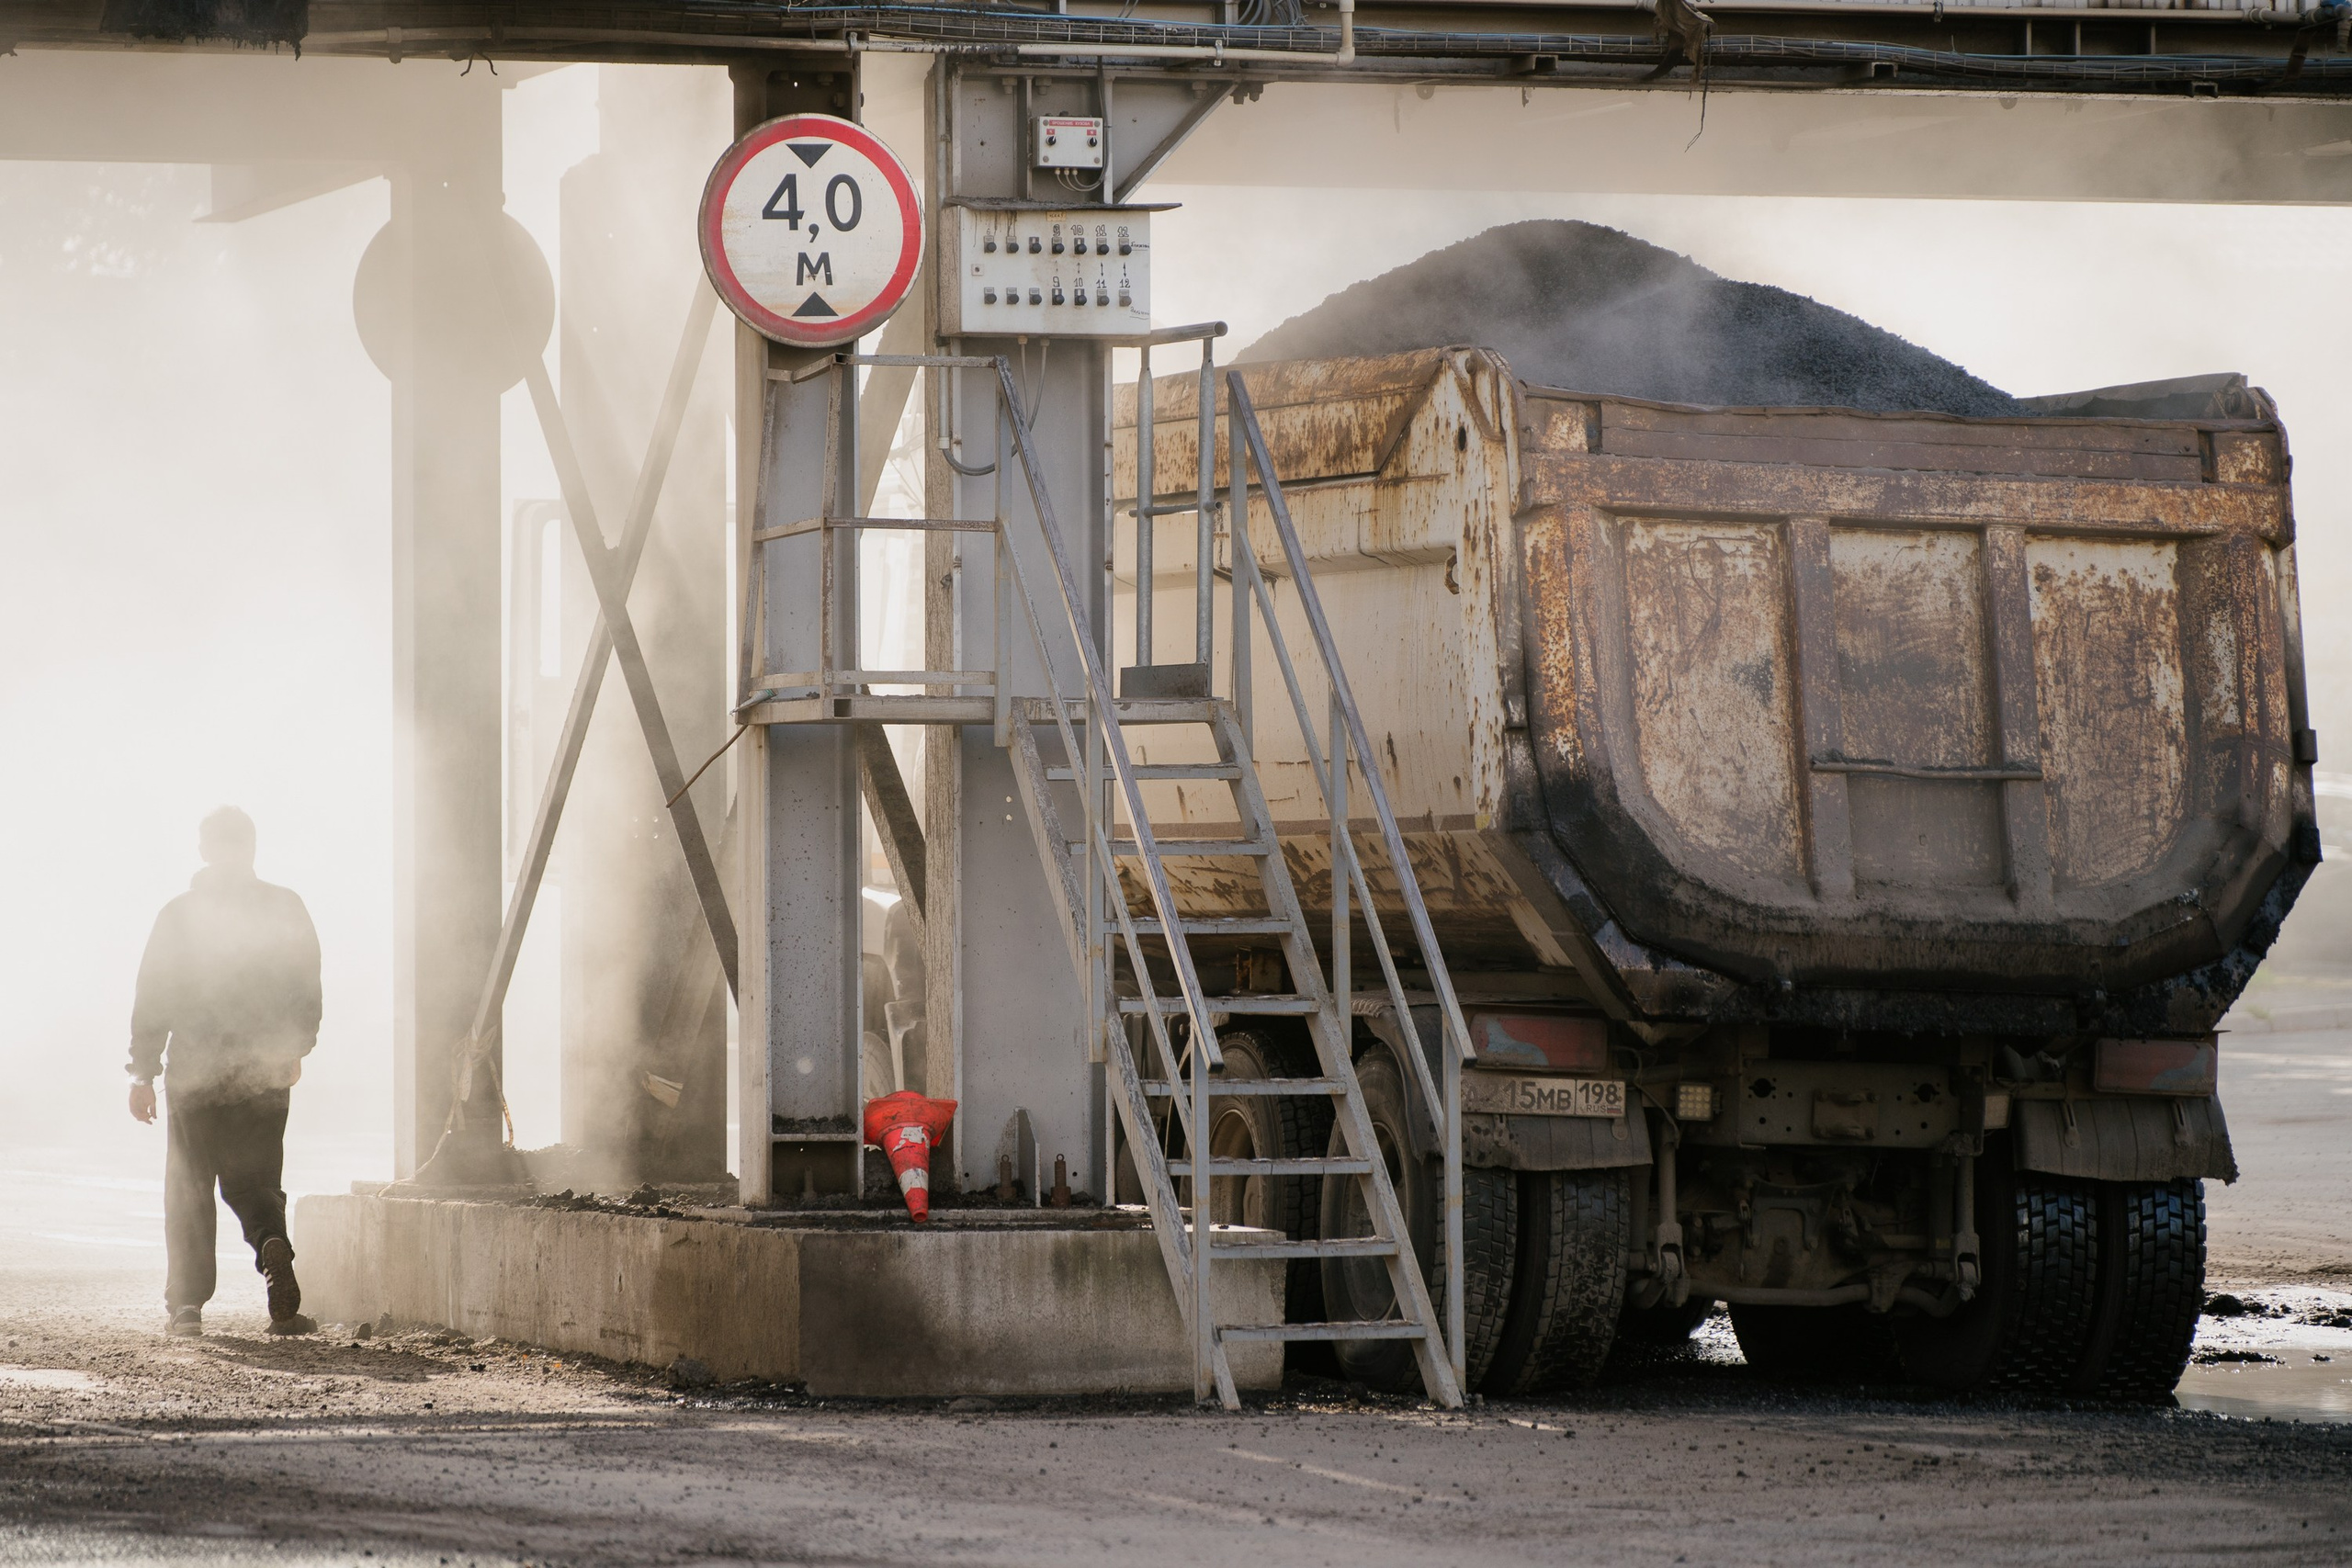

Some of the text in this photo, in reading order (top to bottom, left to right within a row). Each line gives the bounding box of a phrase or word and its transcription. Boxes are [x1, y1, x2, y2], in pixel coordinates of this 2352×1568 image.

[762, 173, 863, 243] 4,0
[1070, 224, 1084, 236] 10
[1095, 224, 1107, 237] 11
[1117, 226, 1129, 238] 12
[1053, 276, 1131, 288] 9 10 11 12
[1578, 1082, 1619, 1105] 198
[1586, 1105, 1606, 1113] RUS
